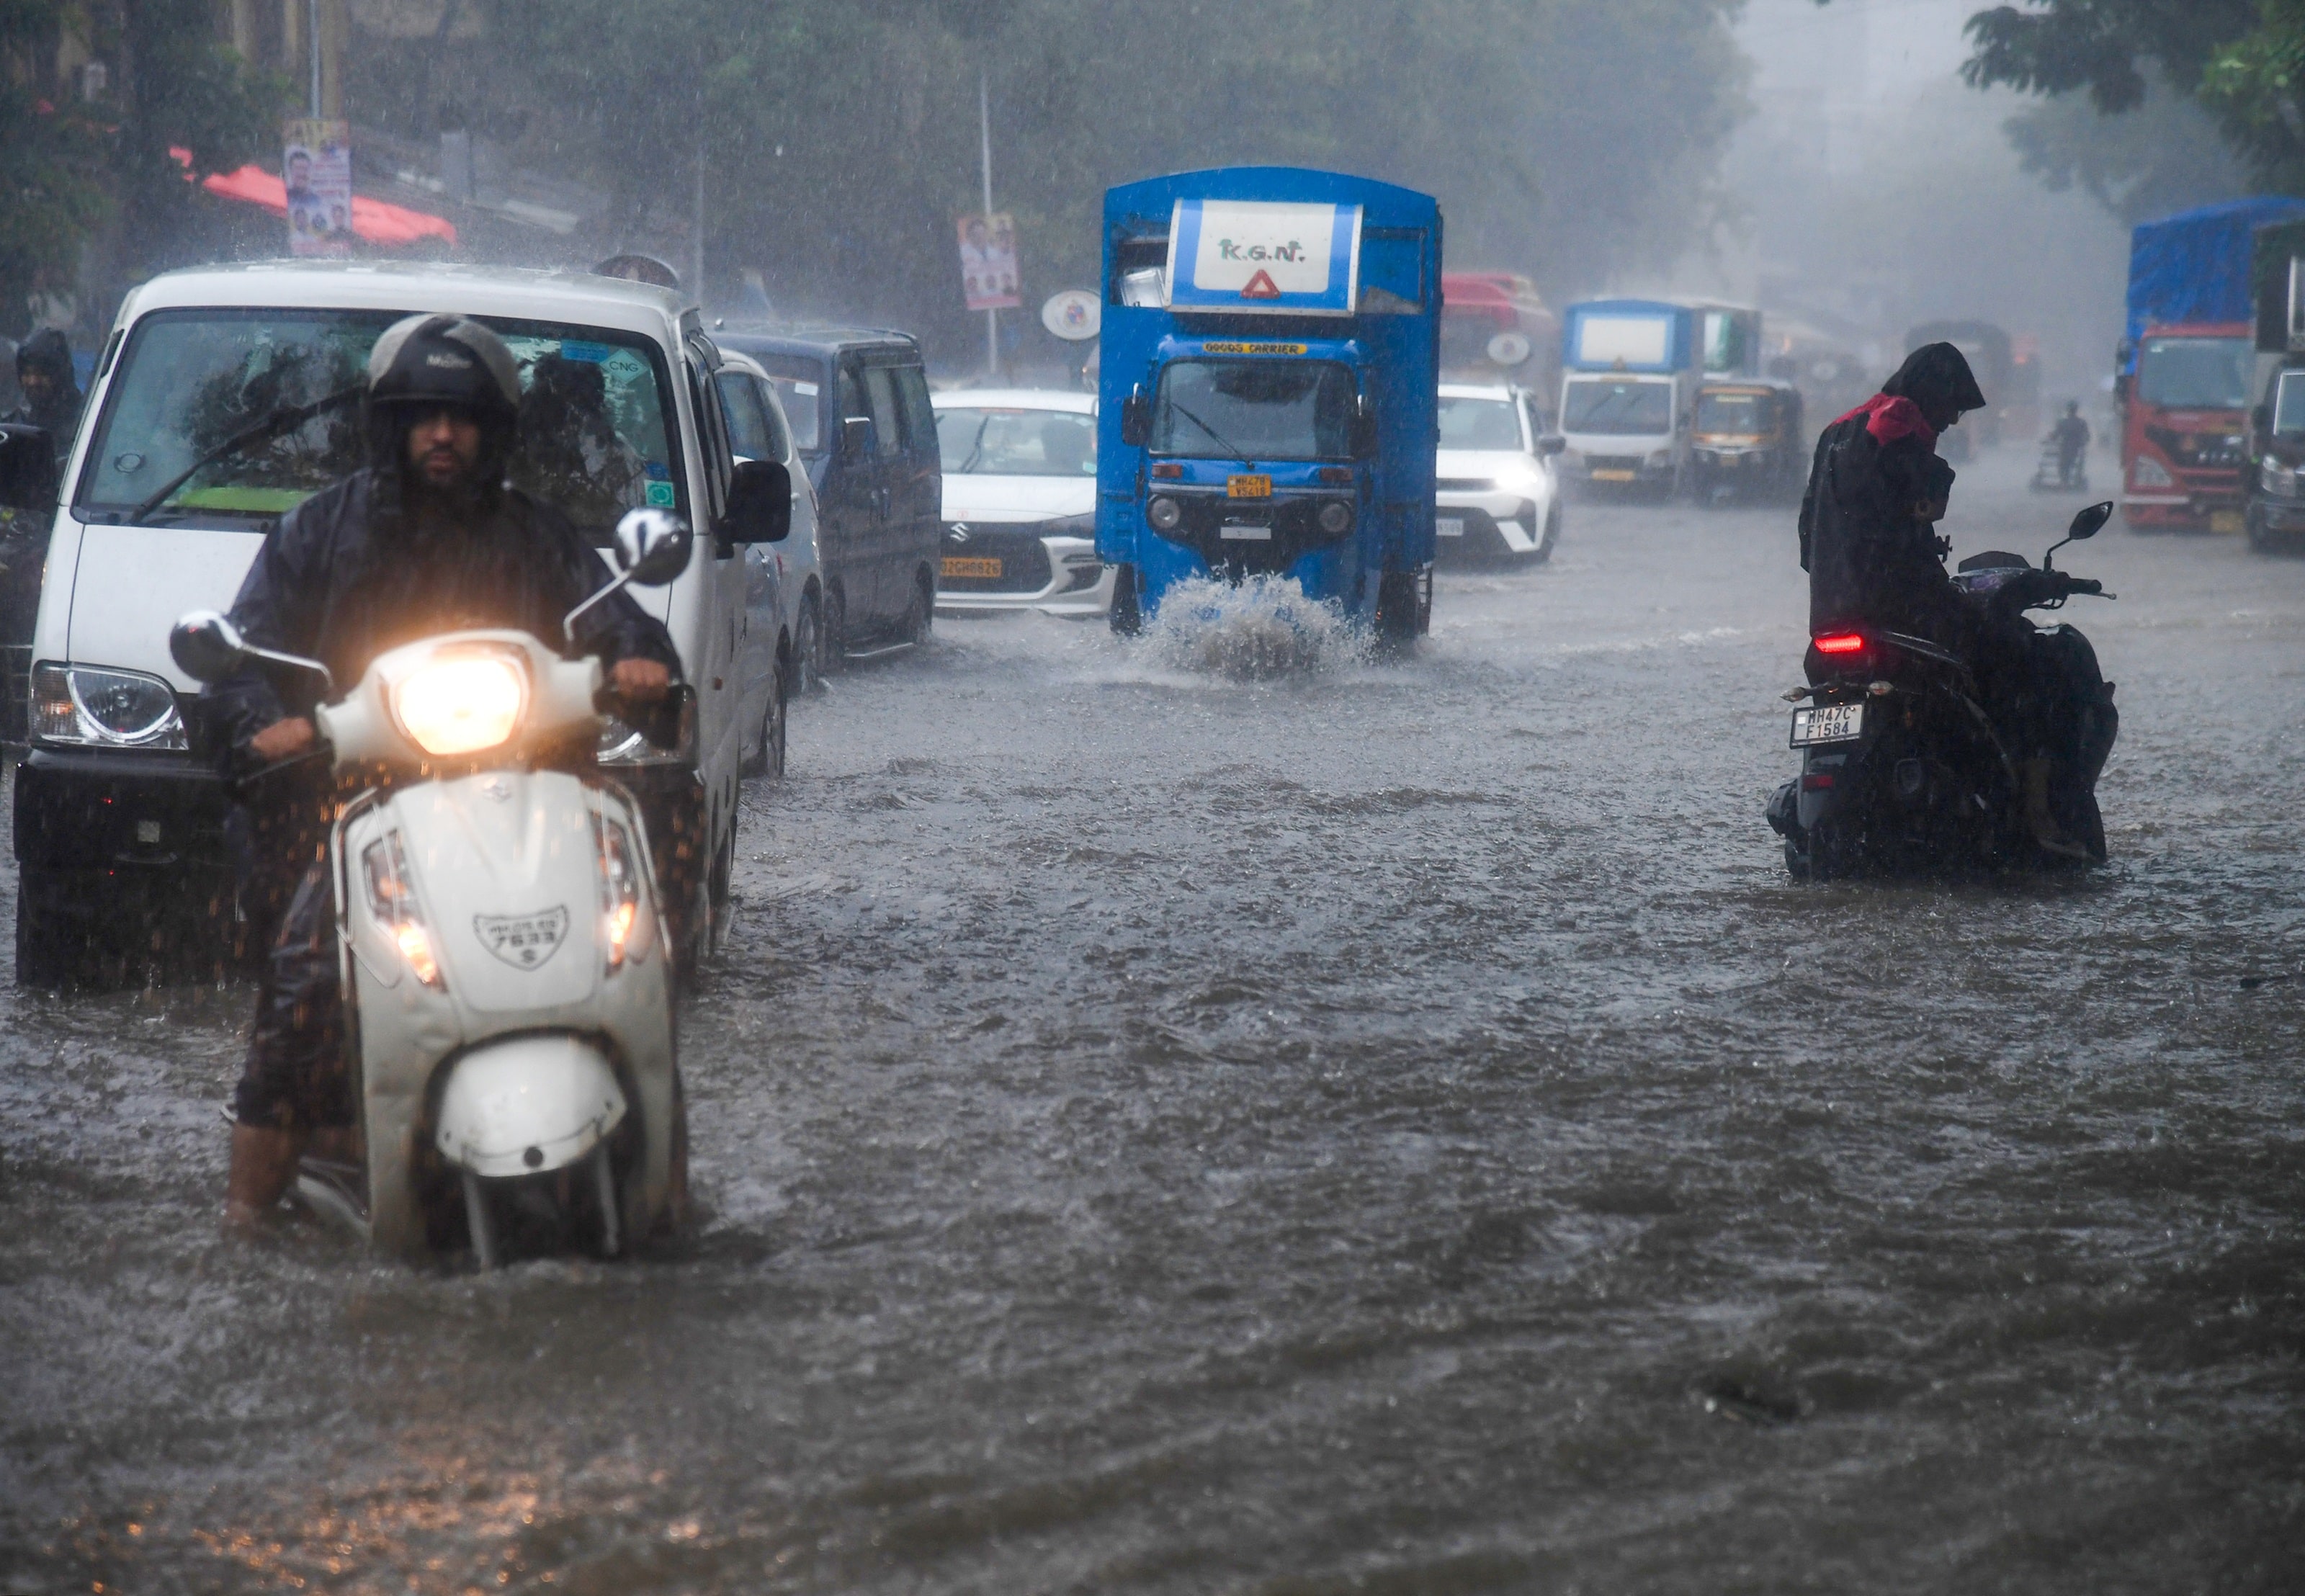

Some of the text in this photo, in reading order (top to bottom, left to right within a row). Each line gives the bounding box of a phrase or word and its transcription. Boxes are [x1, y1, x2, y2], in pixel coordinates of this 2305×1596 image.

[1217, 238, 1306, 263] K.G.N.
[1205, 344, 1299, 354] GOODS CARRIER
[609, 361, 639, 372] CNG
[1808, 704, 1851, 725] MH47C
[1806, 721, 1850, 739] F1584
